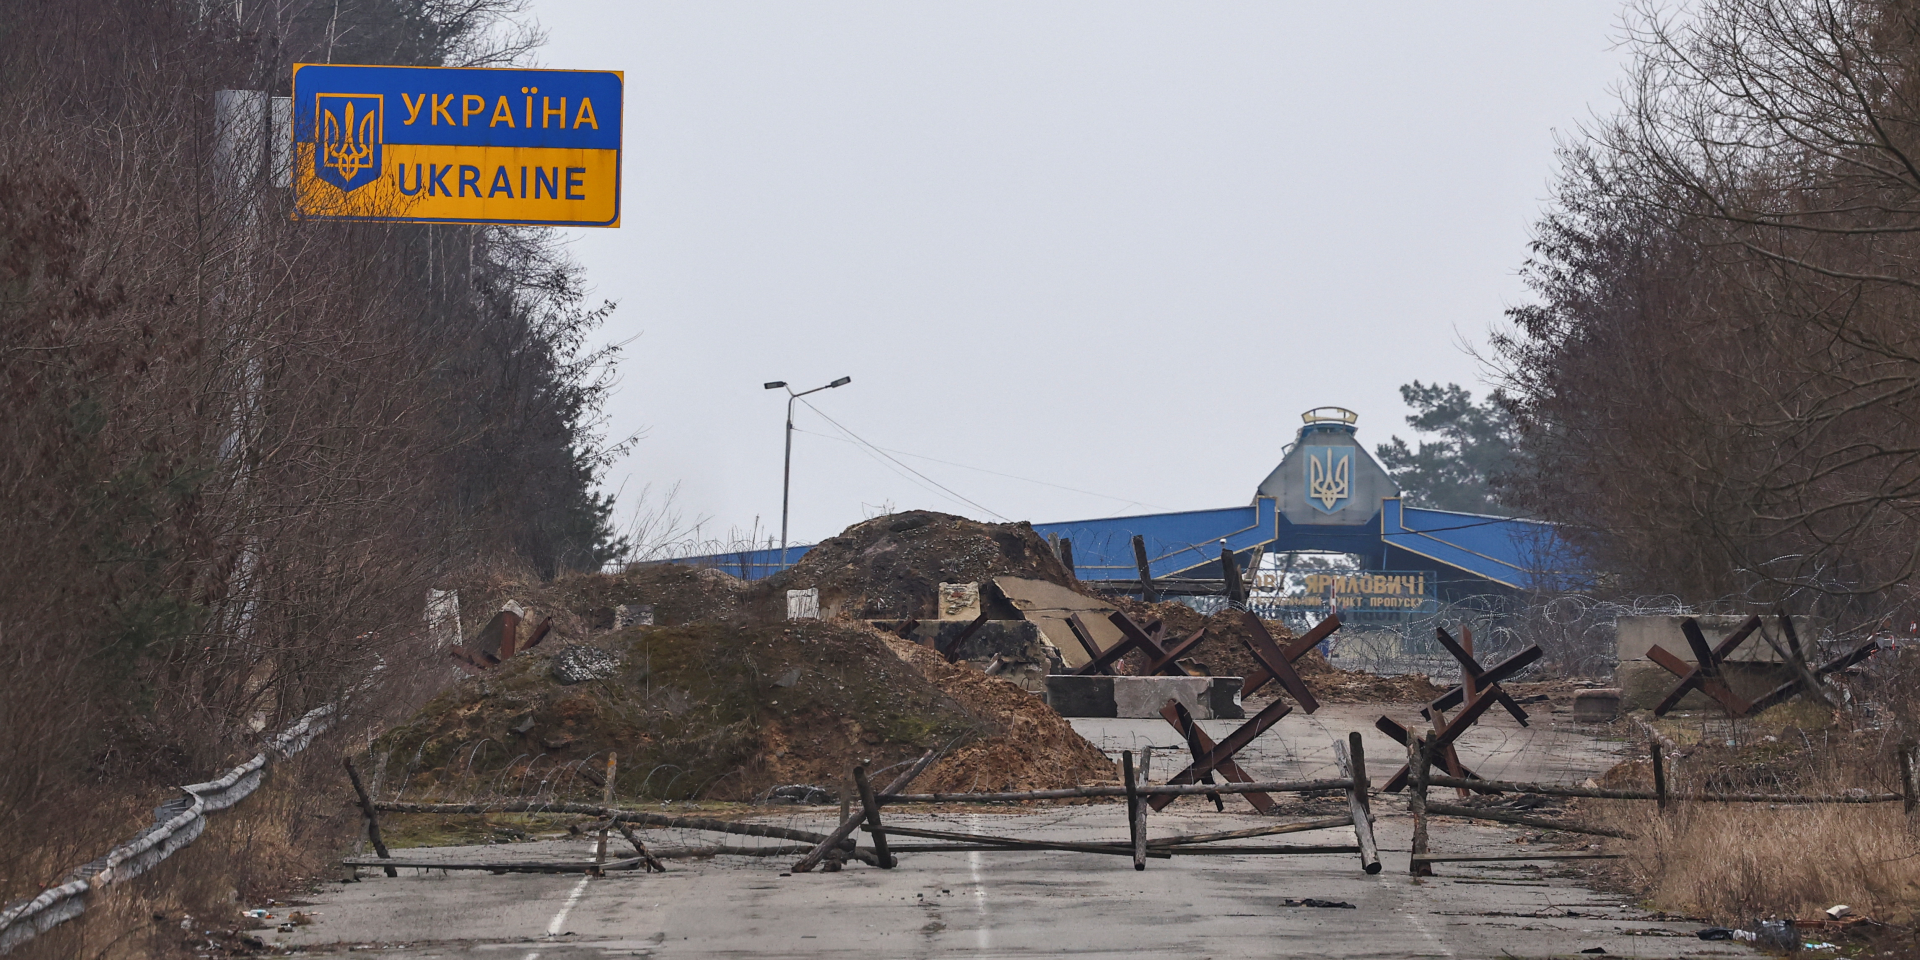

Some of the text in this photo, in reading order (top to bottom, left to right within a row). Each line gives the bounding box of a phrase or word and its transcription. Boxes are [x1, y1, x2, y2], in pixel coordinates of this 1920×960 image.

[401, 86, 599, 130] УКРАЇНА
[399, 163, 586, 200] UKRAINE
[1305, 572, 1424, 595] ЯРИЛОВИЧІ
